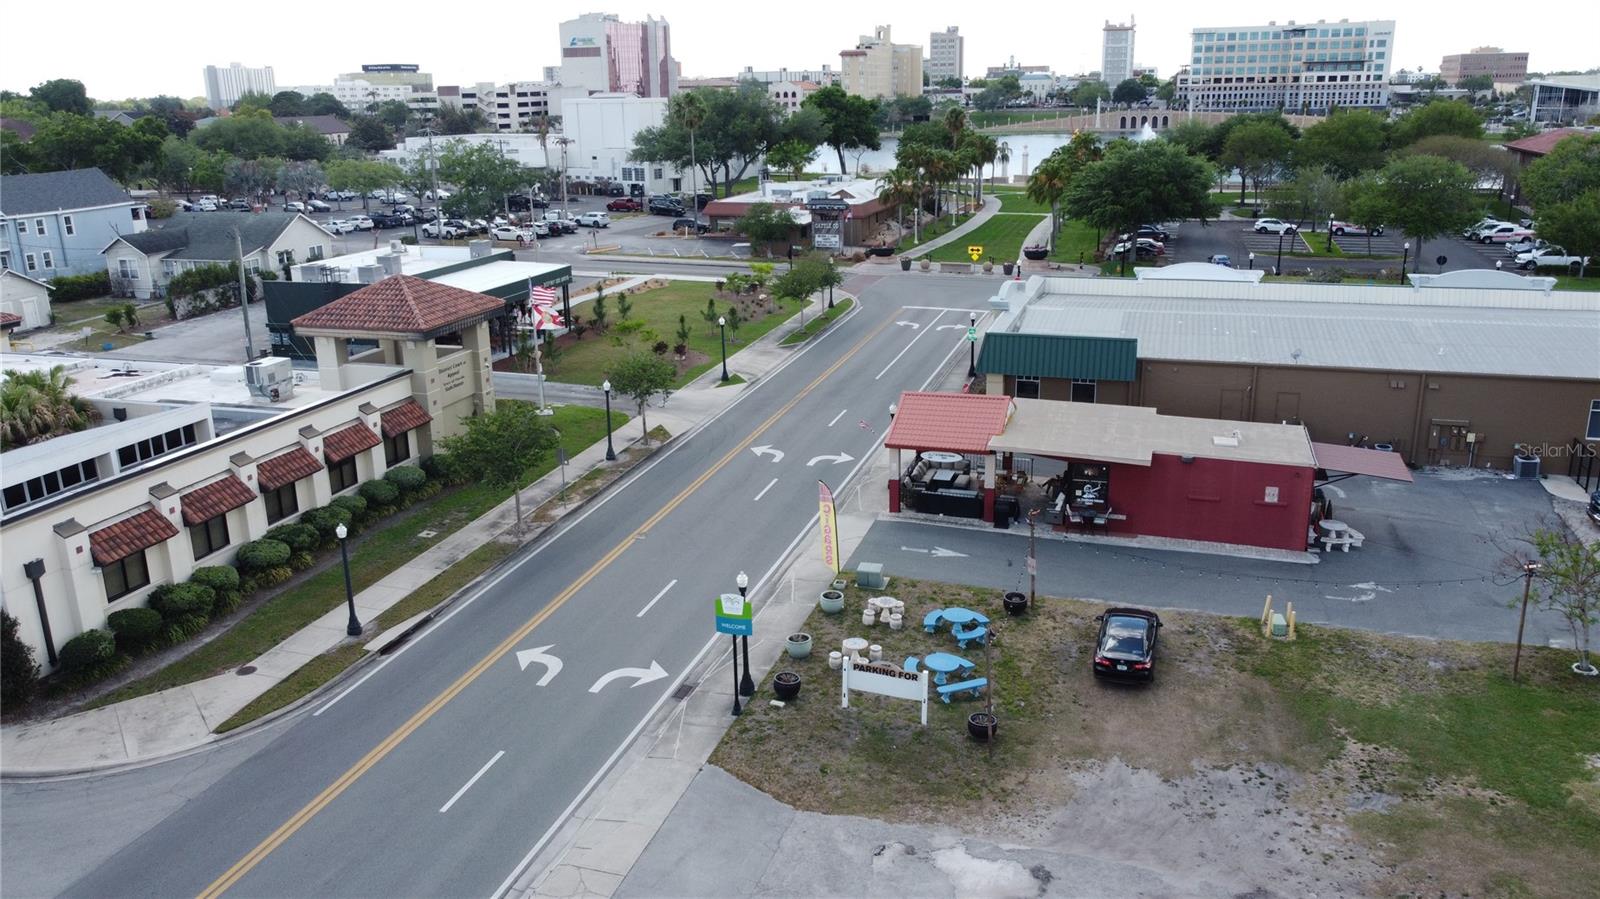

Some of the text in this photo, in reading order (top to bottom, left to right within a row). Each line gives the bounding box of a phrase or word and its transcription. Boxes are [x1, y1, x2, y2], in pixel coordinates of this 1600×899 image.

[721, 622, 746, 630] WELCOME
[853, 663, 919, 681] PARKING FOR
